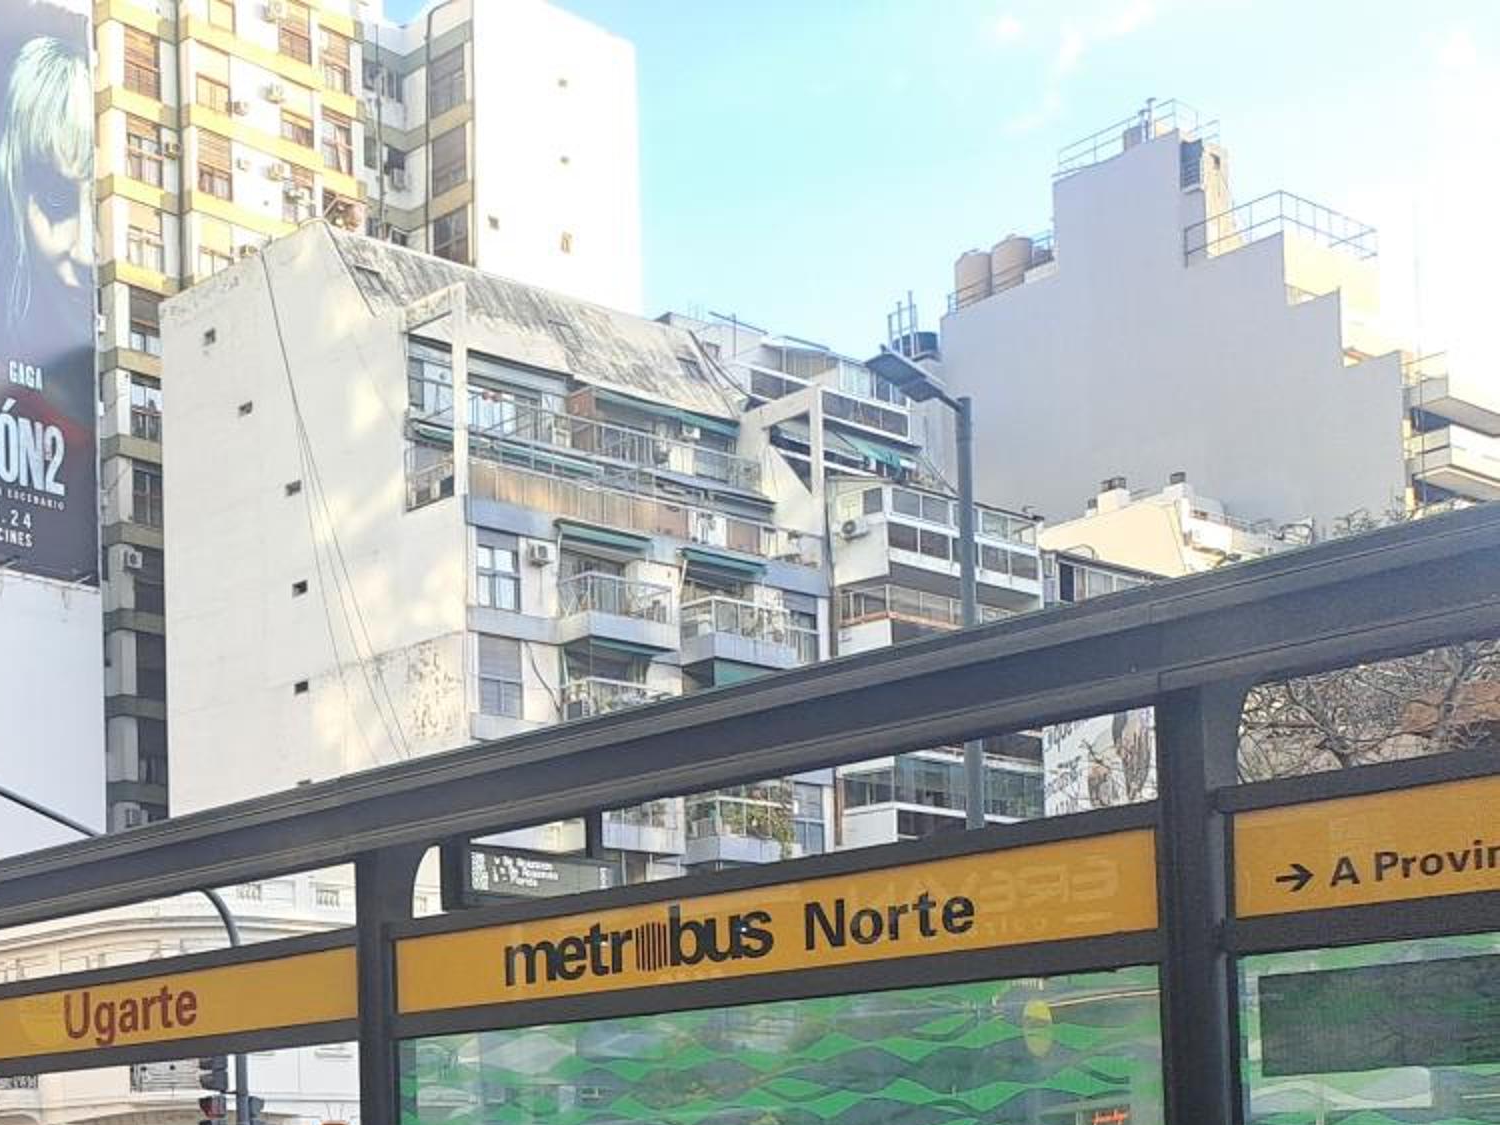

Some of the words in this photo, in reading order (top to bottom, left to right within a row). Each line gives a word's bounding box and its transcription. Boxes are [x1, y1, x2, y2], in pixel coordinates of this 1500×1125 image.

[9, 359, 43, 391] GAGA
[1330, 856, 1361, 887] A
[804, 891, 976, 951] Norte
[63, 985, 197, 1046] Ugarte
